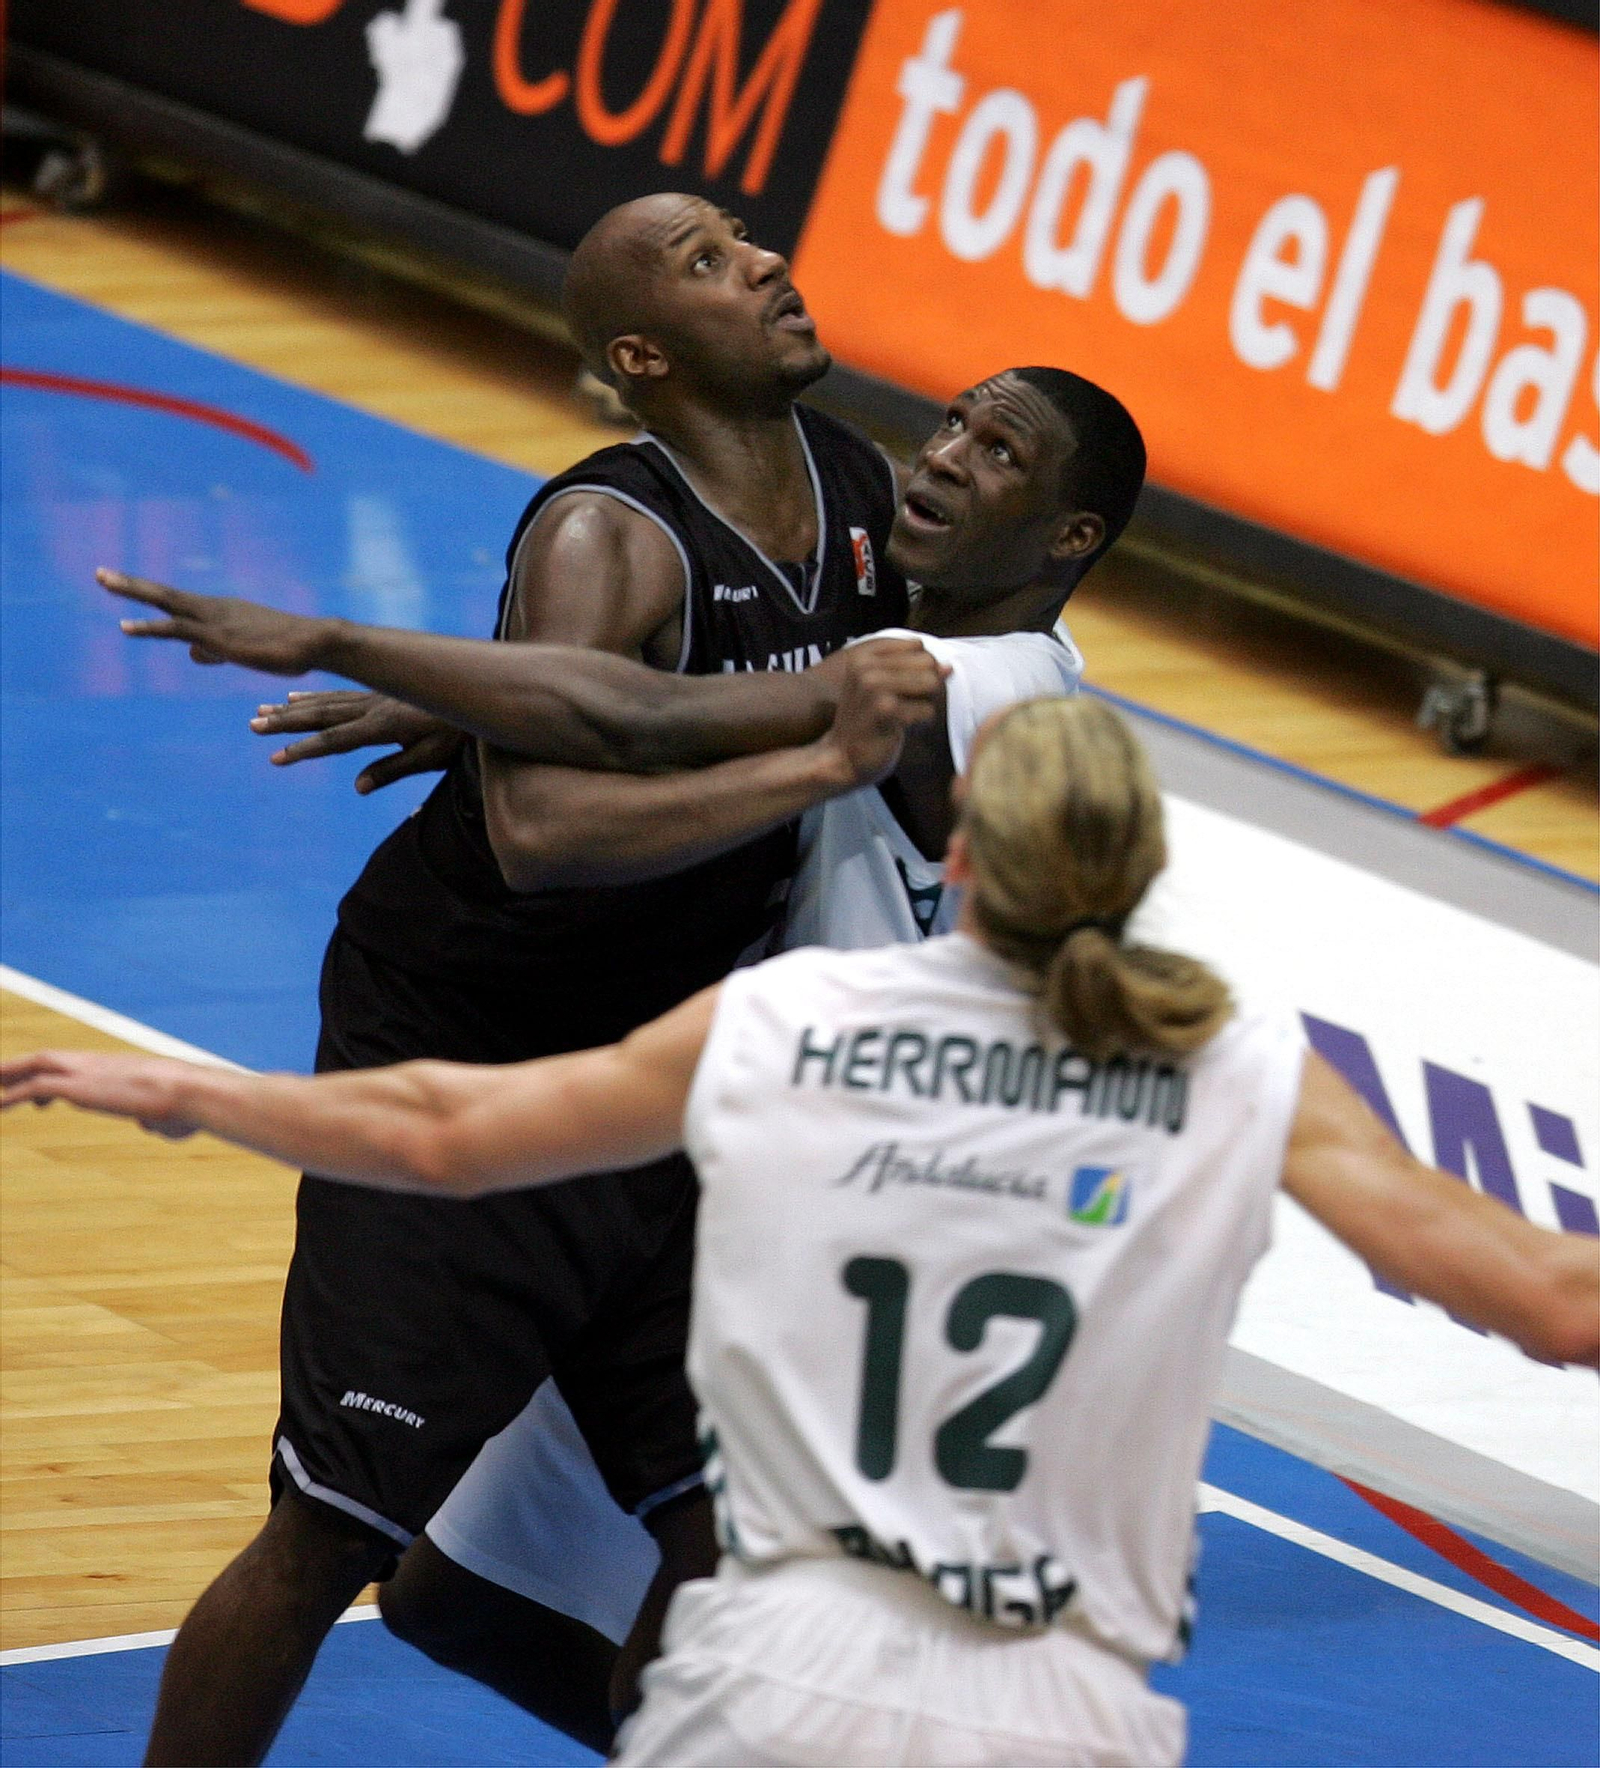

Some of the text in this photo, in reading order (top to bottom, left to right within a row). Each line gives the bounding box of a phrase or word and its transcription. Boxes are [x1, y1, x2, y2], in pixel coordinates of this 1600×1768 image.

[876, 8, 1212, 326] todo
[1228, 165, 1400, 394] el
[791, 1026, 1190, 1136] HERRMANN
[340, 1390, 425, 1429] MERCURY
[841, 1255, 1079, 1493] 12
